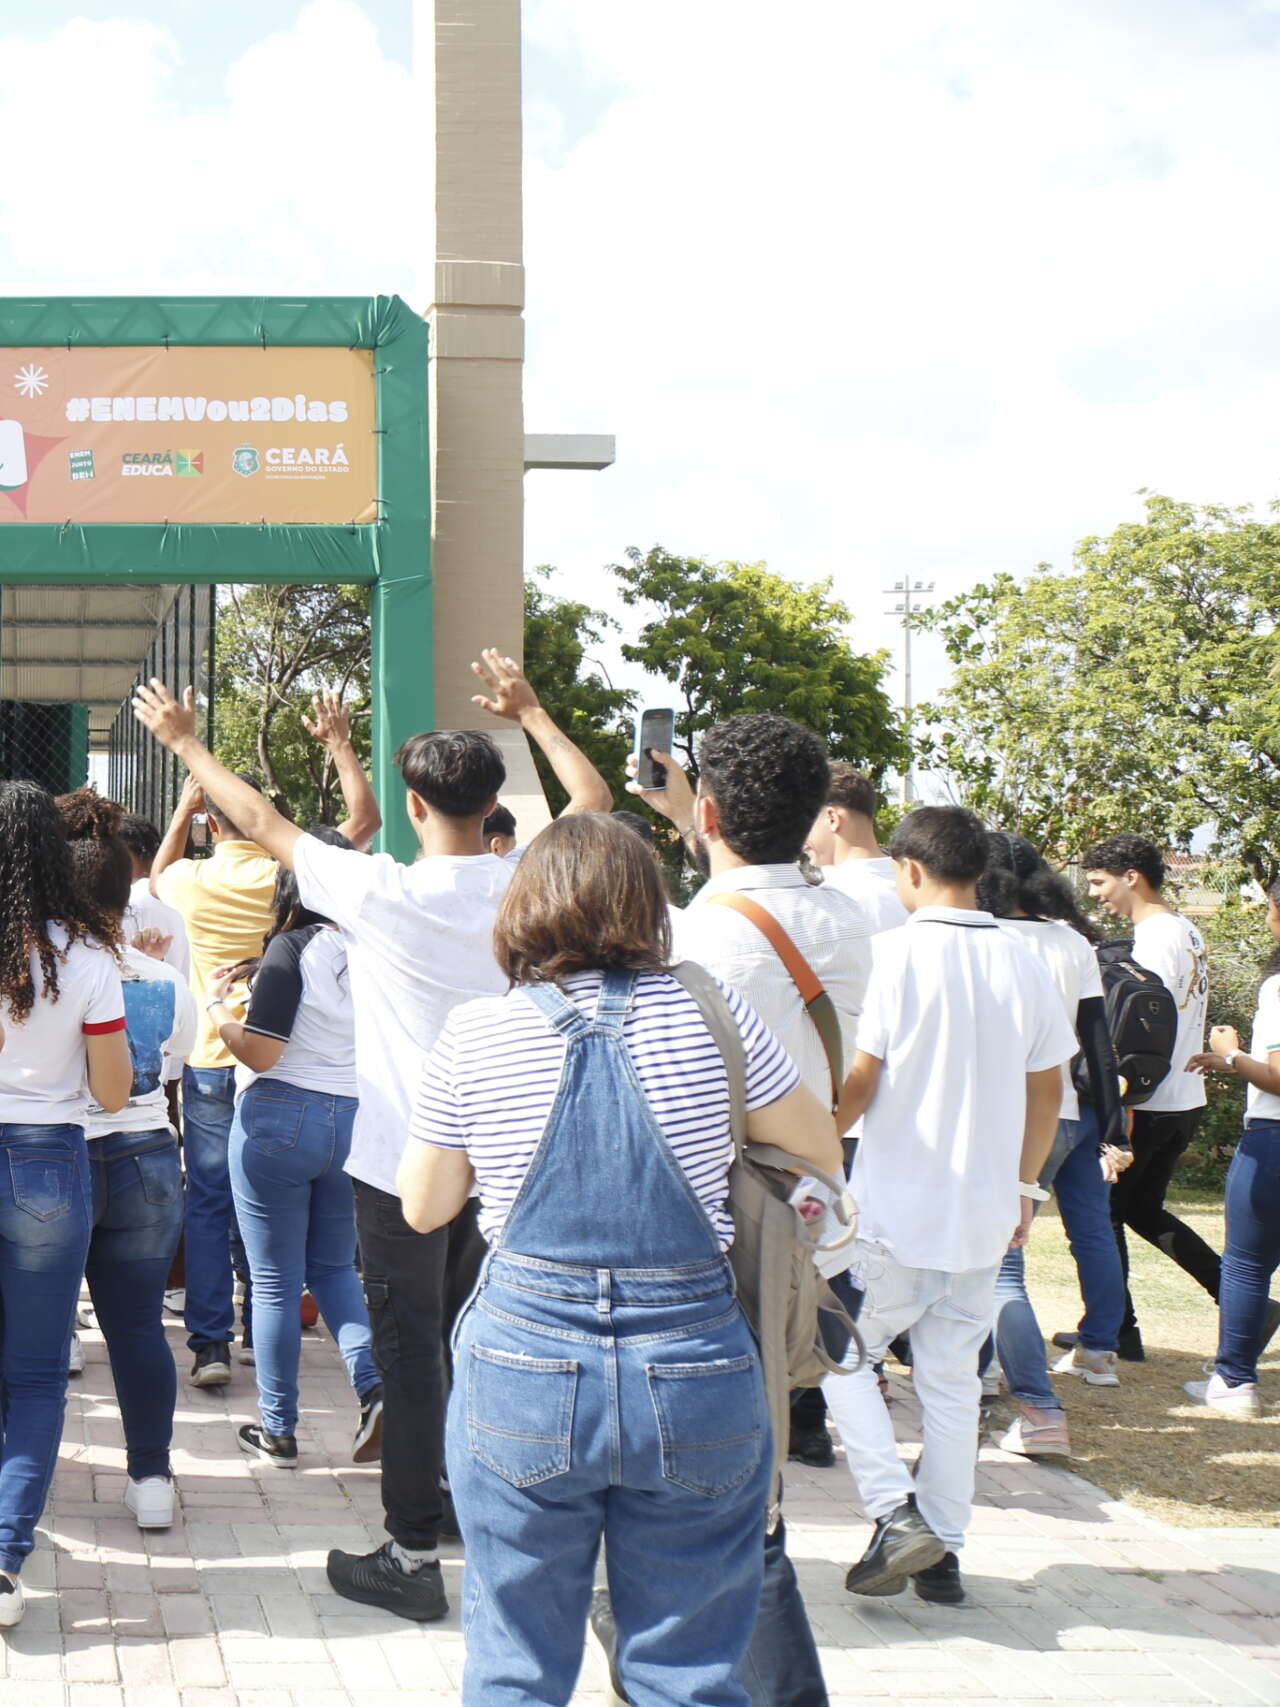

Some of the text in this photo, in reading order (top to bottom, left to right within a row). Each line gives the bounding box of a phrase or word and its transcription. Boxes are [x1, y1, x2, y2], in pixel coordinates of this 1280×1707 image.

[65, 394, 348, 422] #ENEMVou2Dias
[122, 449, 172, 464] CEARÁ
[265, 443, 349, 464] CEARÁ
[121, 464, 173, 476] EDUCA
